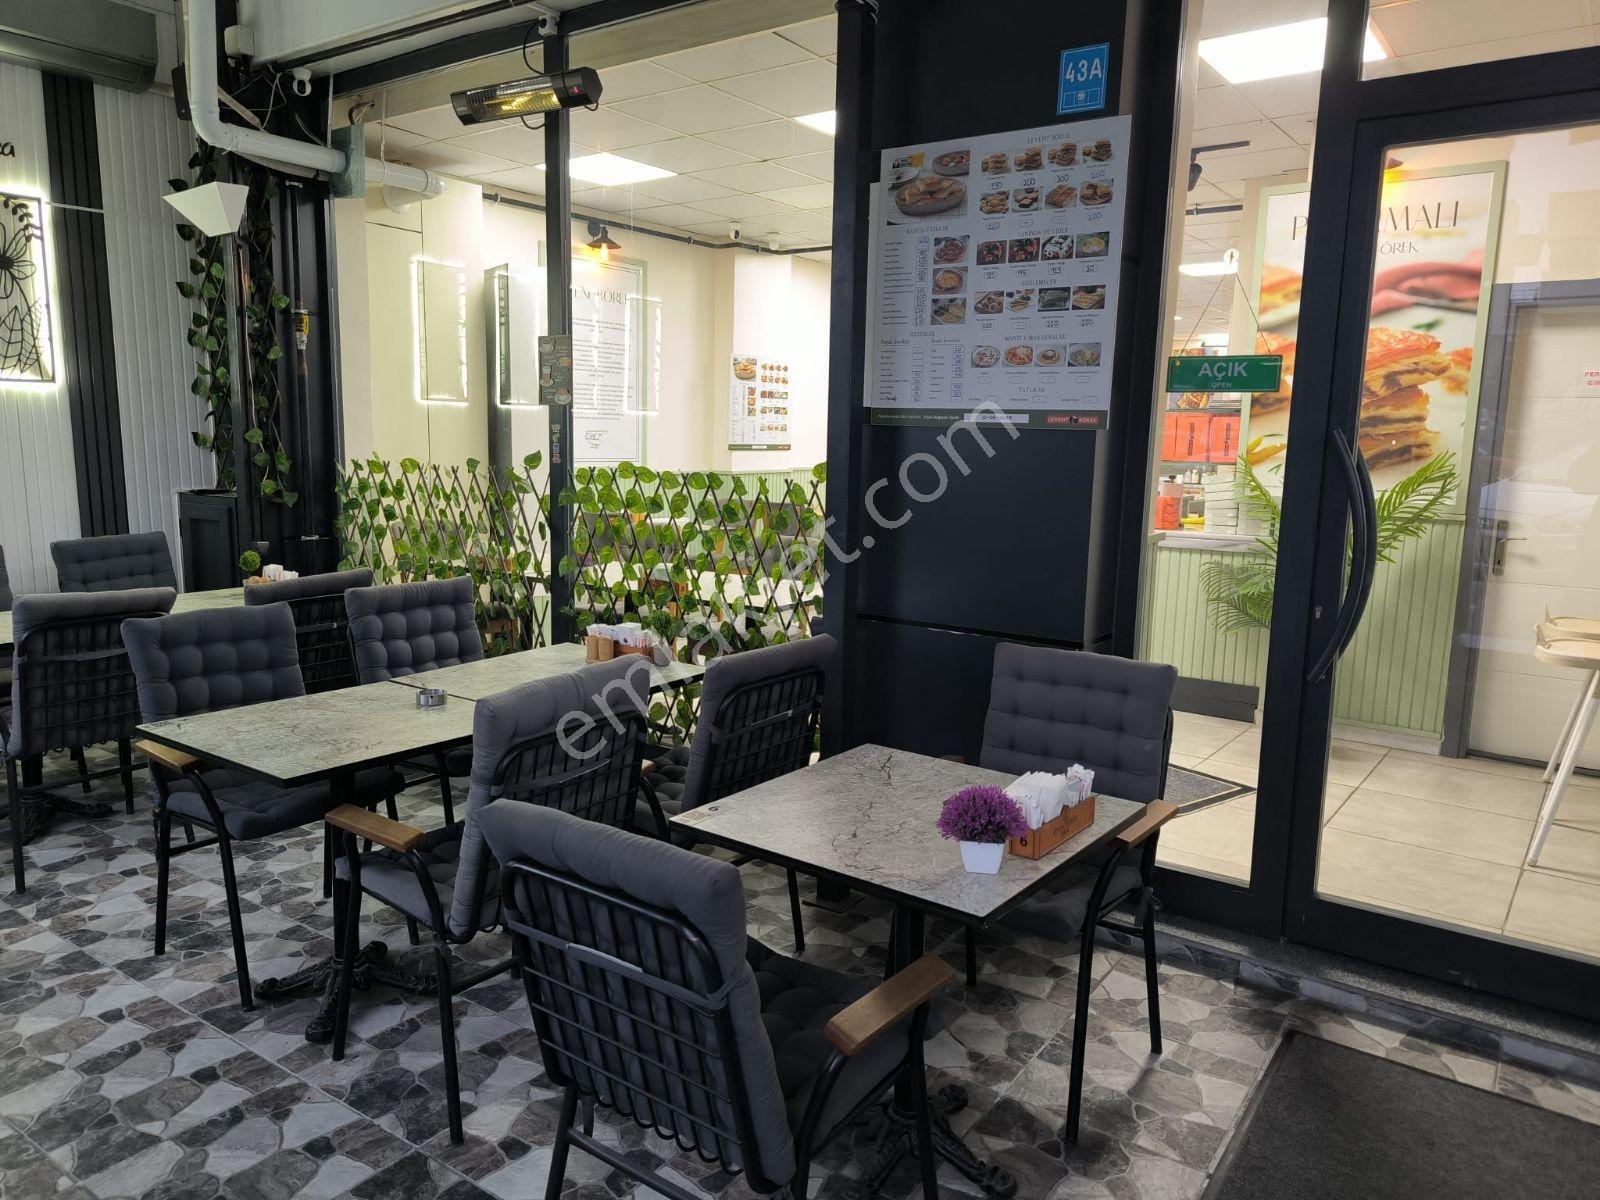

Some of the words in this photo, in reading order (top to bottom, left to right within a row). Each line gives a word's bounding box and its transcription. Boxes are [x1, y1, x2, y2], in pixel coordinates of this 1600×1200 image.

[1065, 58, 1102, 83] 43A
[1380, 241, 1418, 255] ÖREK
[1198, 362, 1249, 381] AÇIK
[1211, 381, 1232, 389] OPEN
